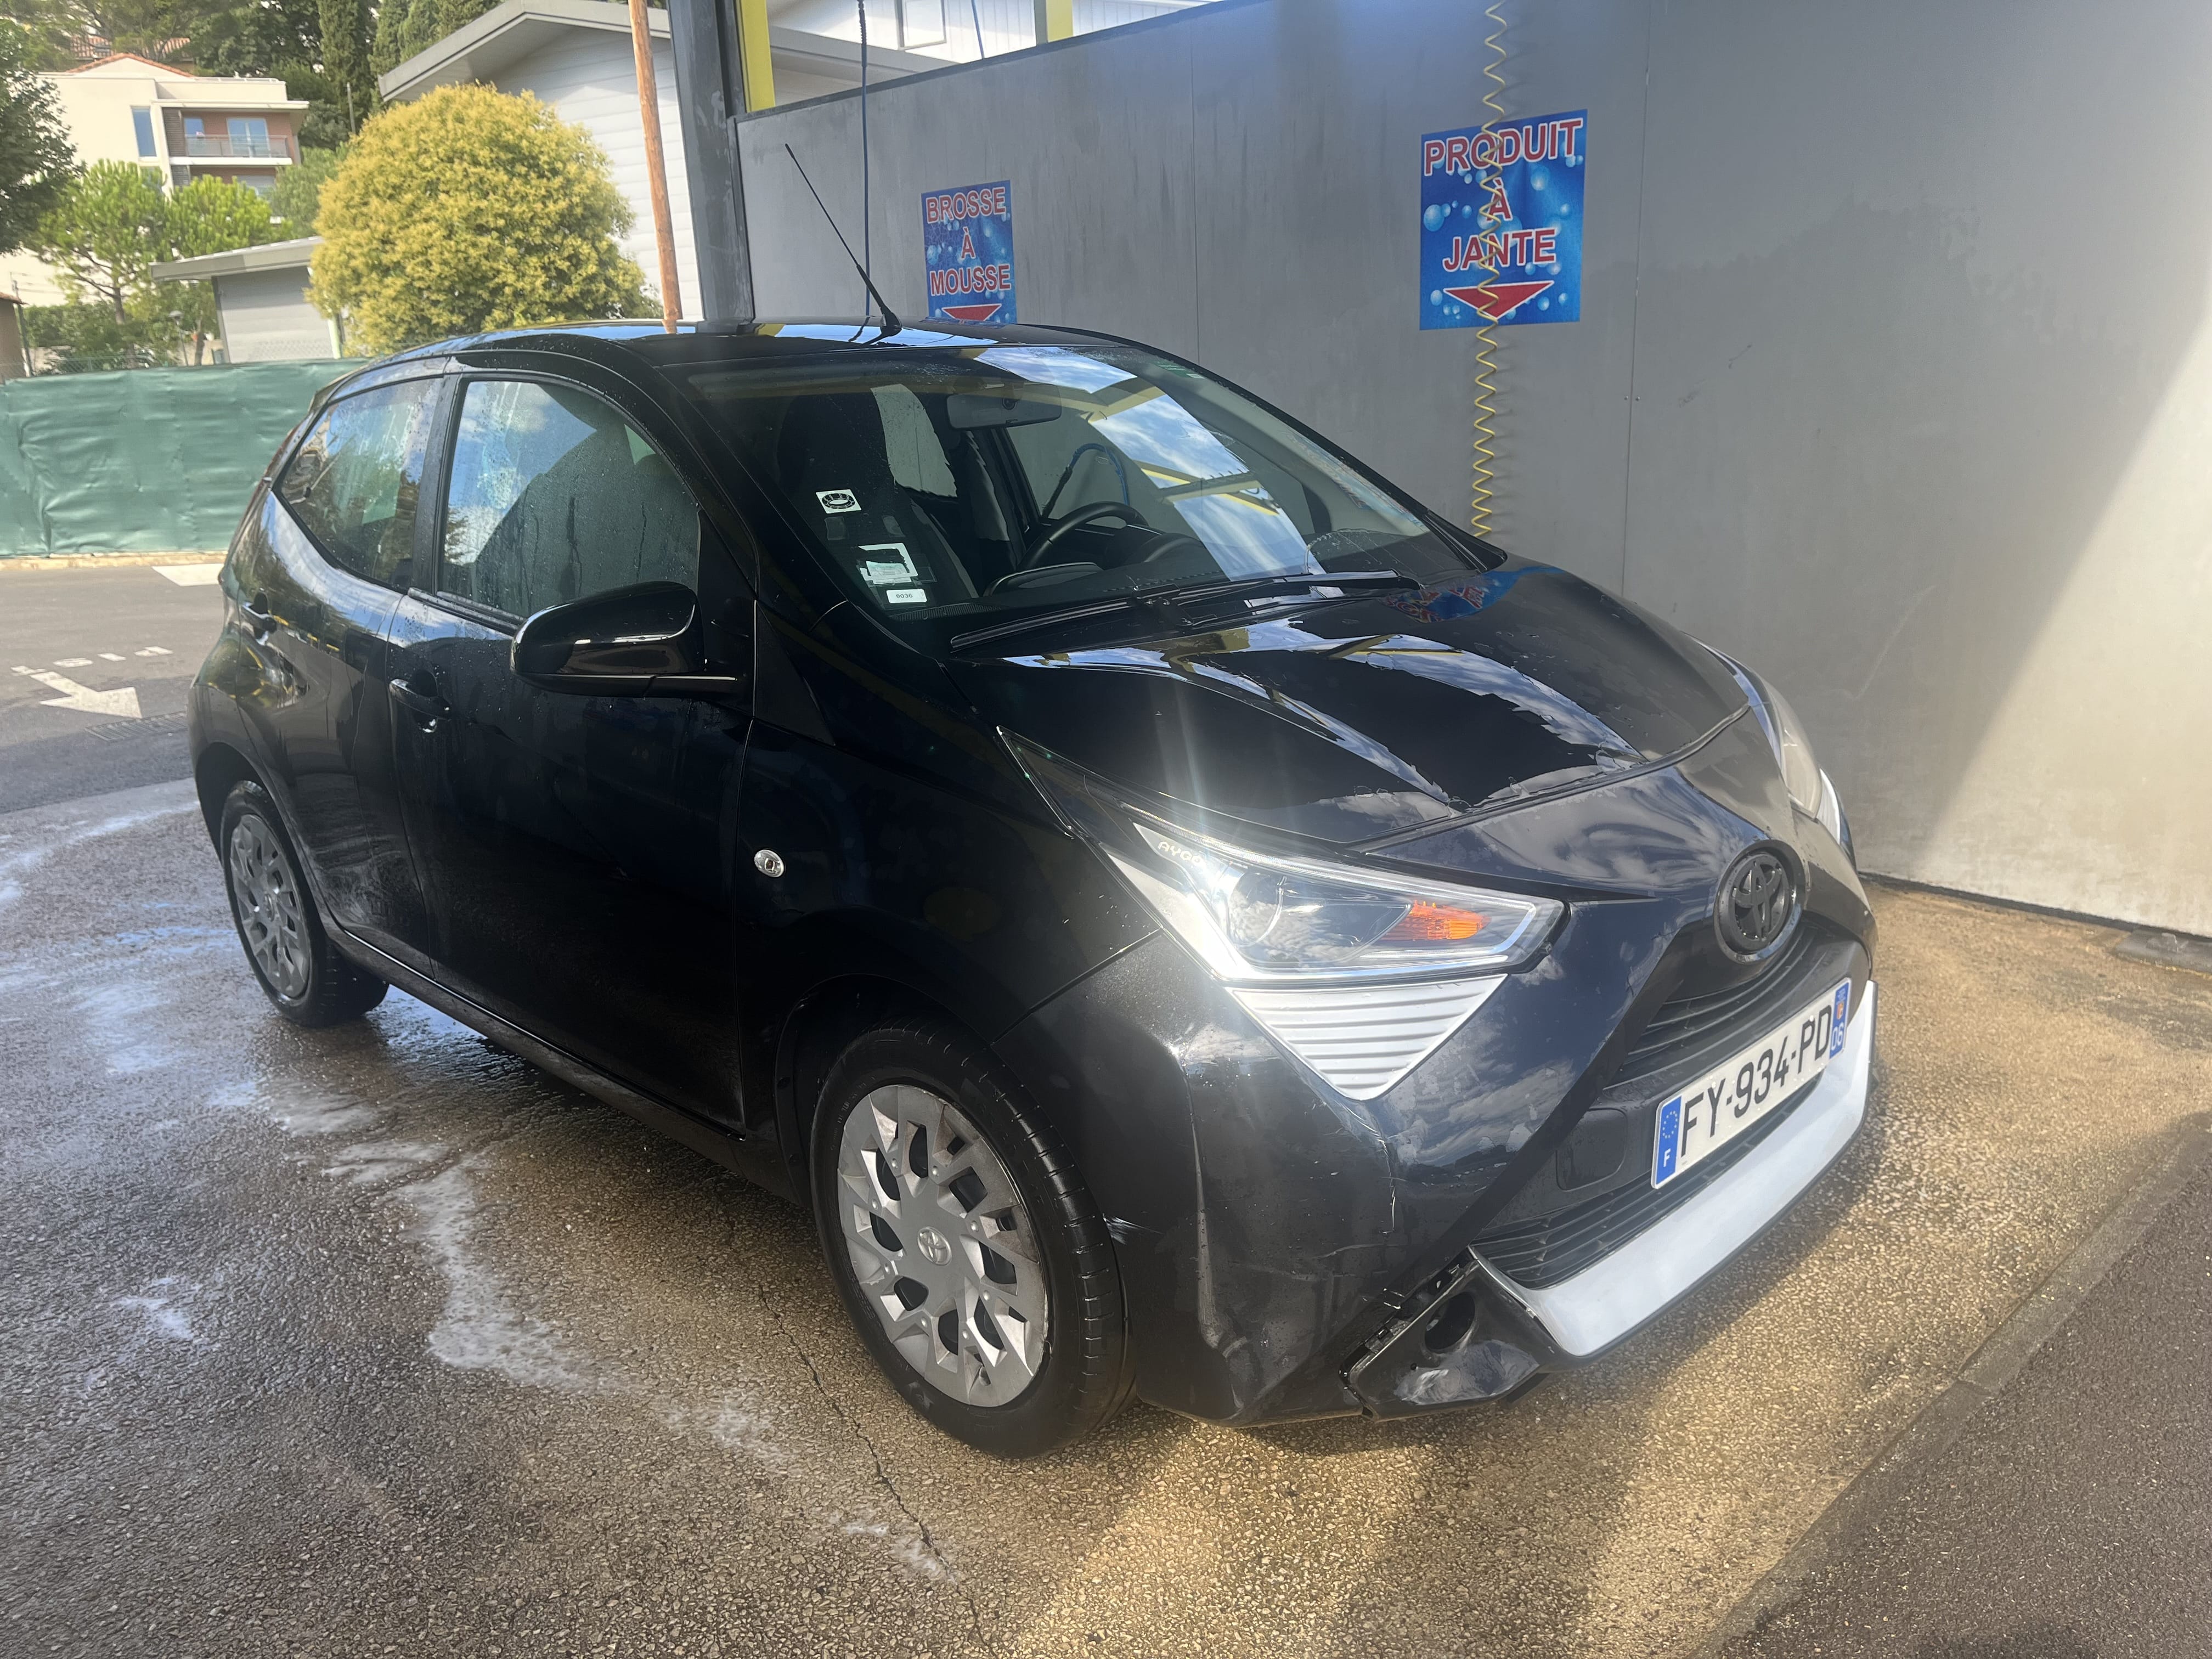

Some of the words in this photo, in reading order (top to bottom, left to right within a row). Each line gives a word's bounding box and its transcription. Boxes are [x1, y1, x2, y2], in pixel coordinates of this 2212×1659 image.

[1424, 118, 1583, 176] PRODUIT
[926, 187, 1006, 224] BROSSE
[961, 226, 975, 259] À
[1442, 228, 1556, 272] JANTE
[930, 264, 1011, 296] MOUSSE
[1158, 842, 1205, 867] AYGO
[1830, 1022, 1845, 1051] 06
[1680, 1005, 1832, 1158] FY-934-PD
[1663, 1148, 1671, 1167] F
